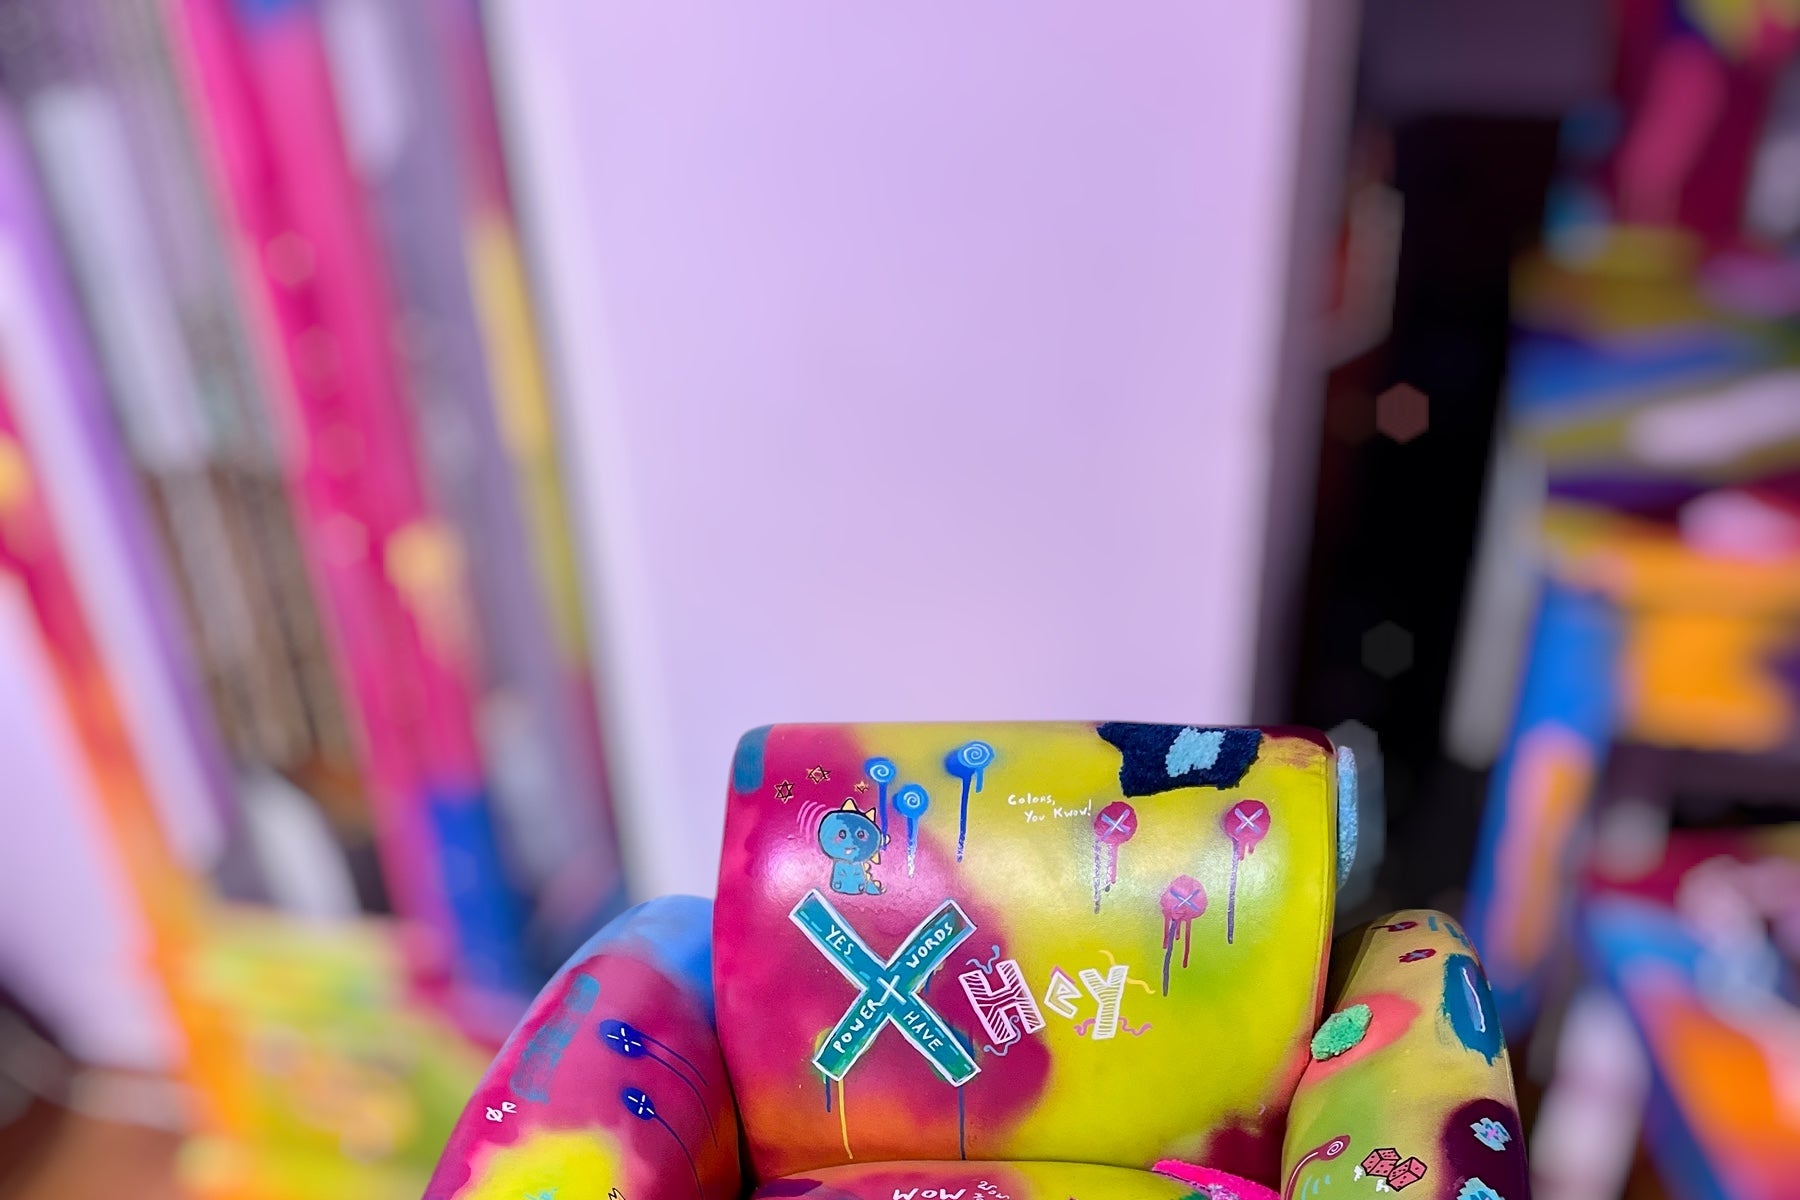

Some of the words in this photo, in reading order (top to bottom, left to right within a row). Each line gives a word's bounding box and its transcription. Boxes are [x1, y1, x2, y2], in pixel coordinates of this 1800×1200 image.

[825, 924, 854, 956] YES
[905, 920, 954, 969] WORDS
[832, 998, 883, 1054] POWER
[903, 1010, 944, 1052] HAVE
